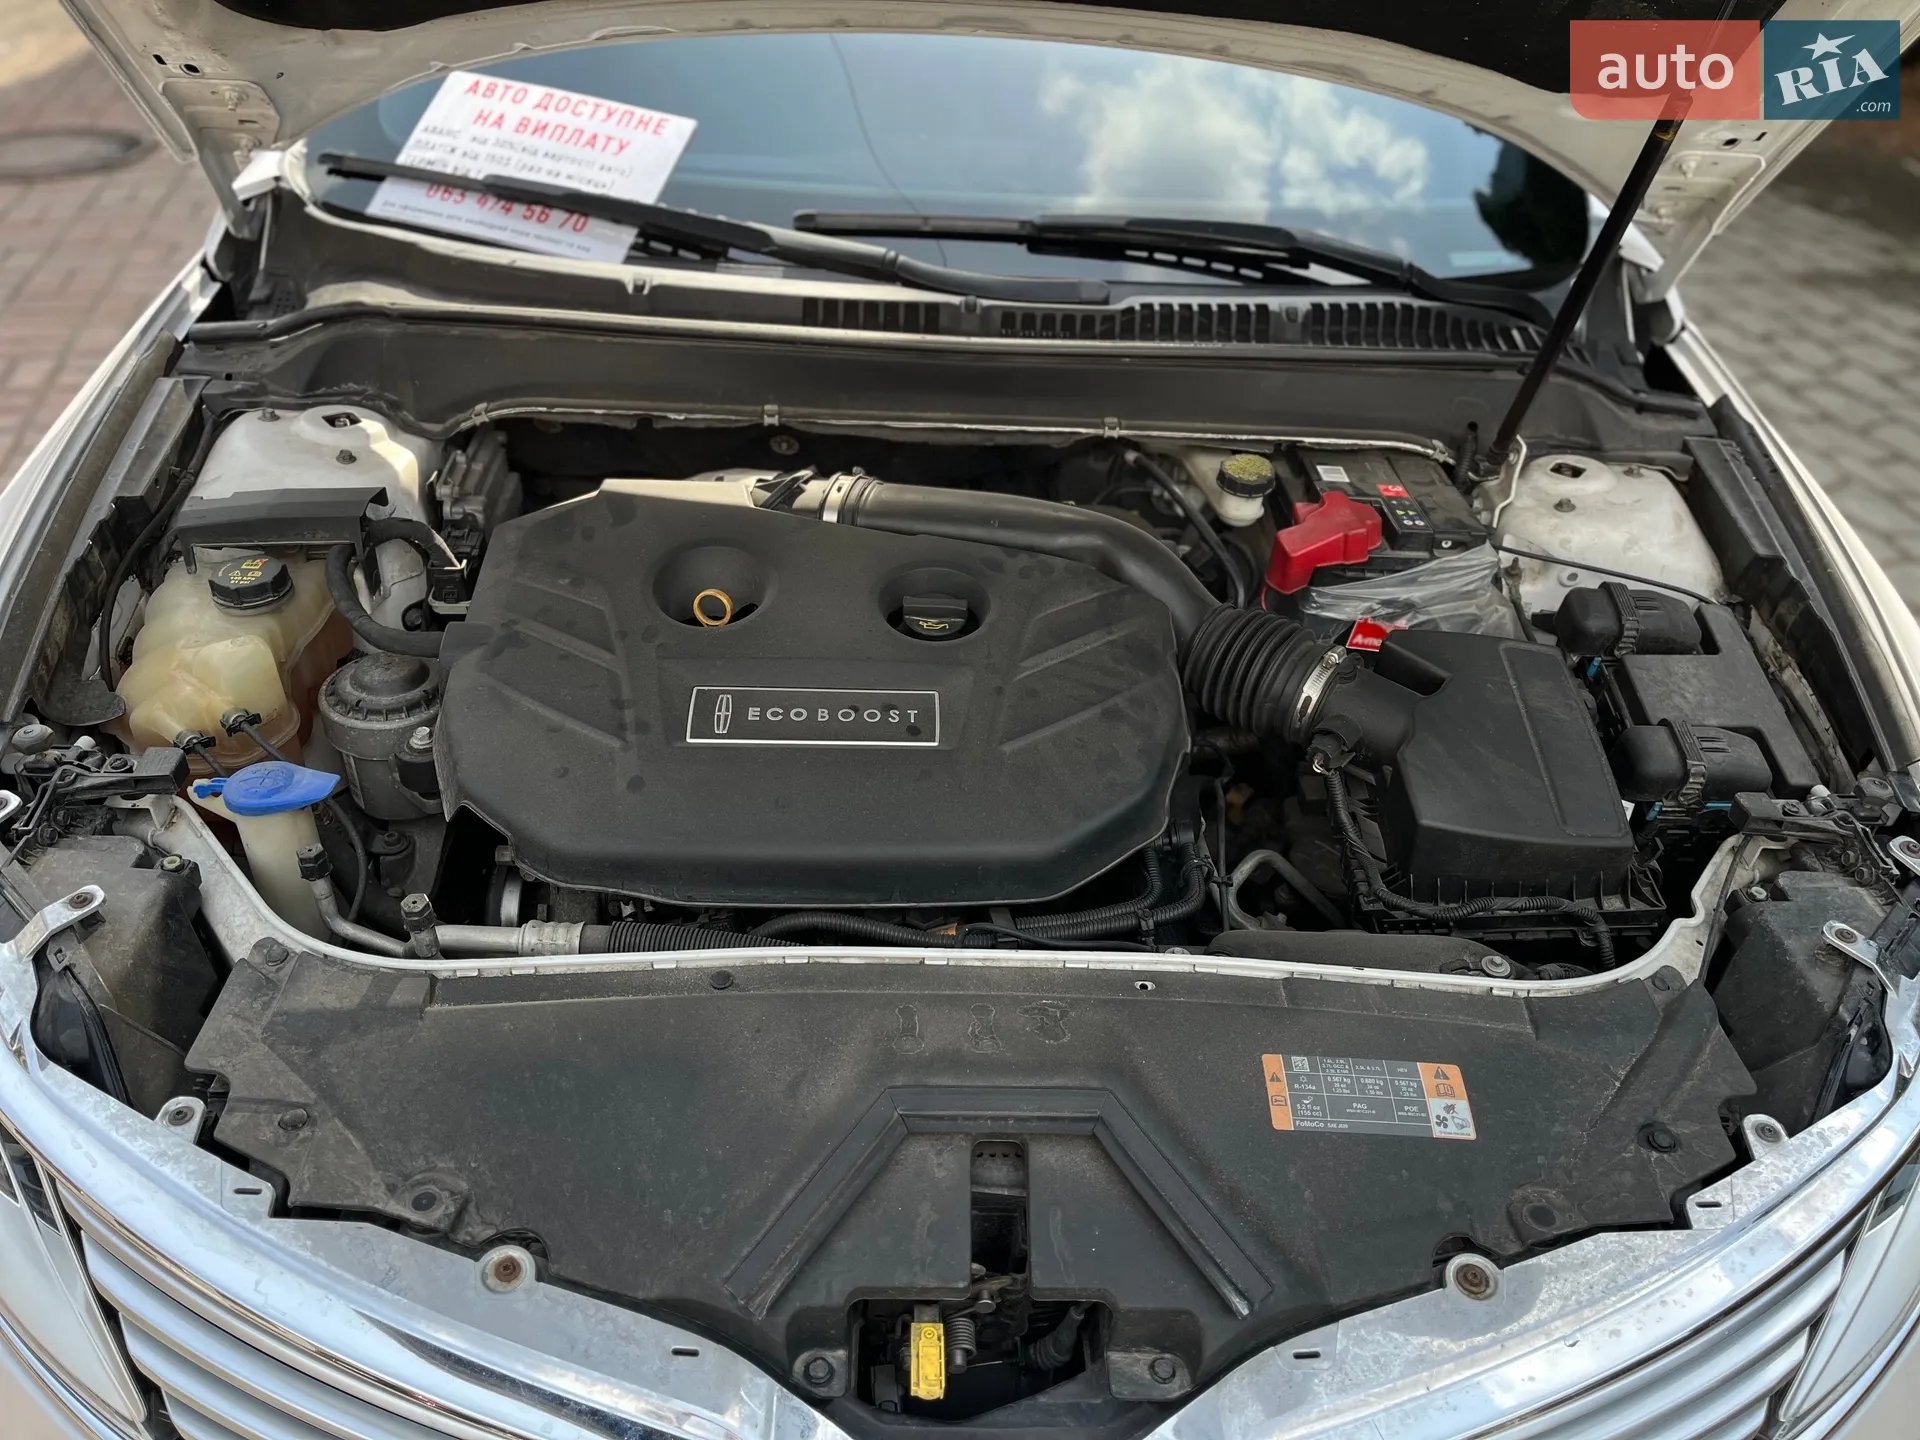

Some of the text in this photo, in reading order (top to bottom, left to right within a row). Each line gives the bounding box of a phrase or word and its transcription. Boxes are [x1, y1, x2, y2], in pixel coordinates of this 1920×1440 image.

[464, 79, 670, 137] АВТО ДОСТУПНЕ
[473, 109, 631, 156] НА ВИПЛАТУ
[425, 182, 466, 206] 063
[522, 203, 553, 224] 56
[558, 209, 590, 233] 70
[748, 707, 918, 723] ECOBOOST
[1295, 1120, 1325, 1128] FoMoCo
